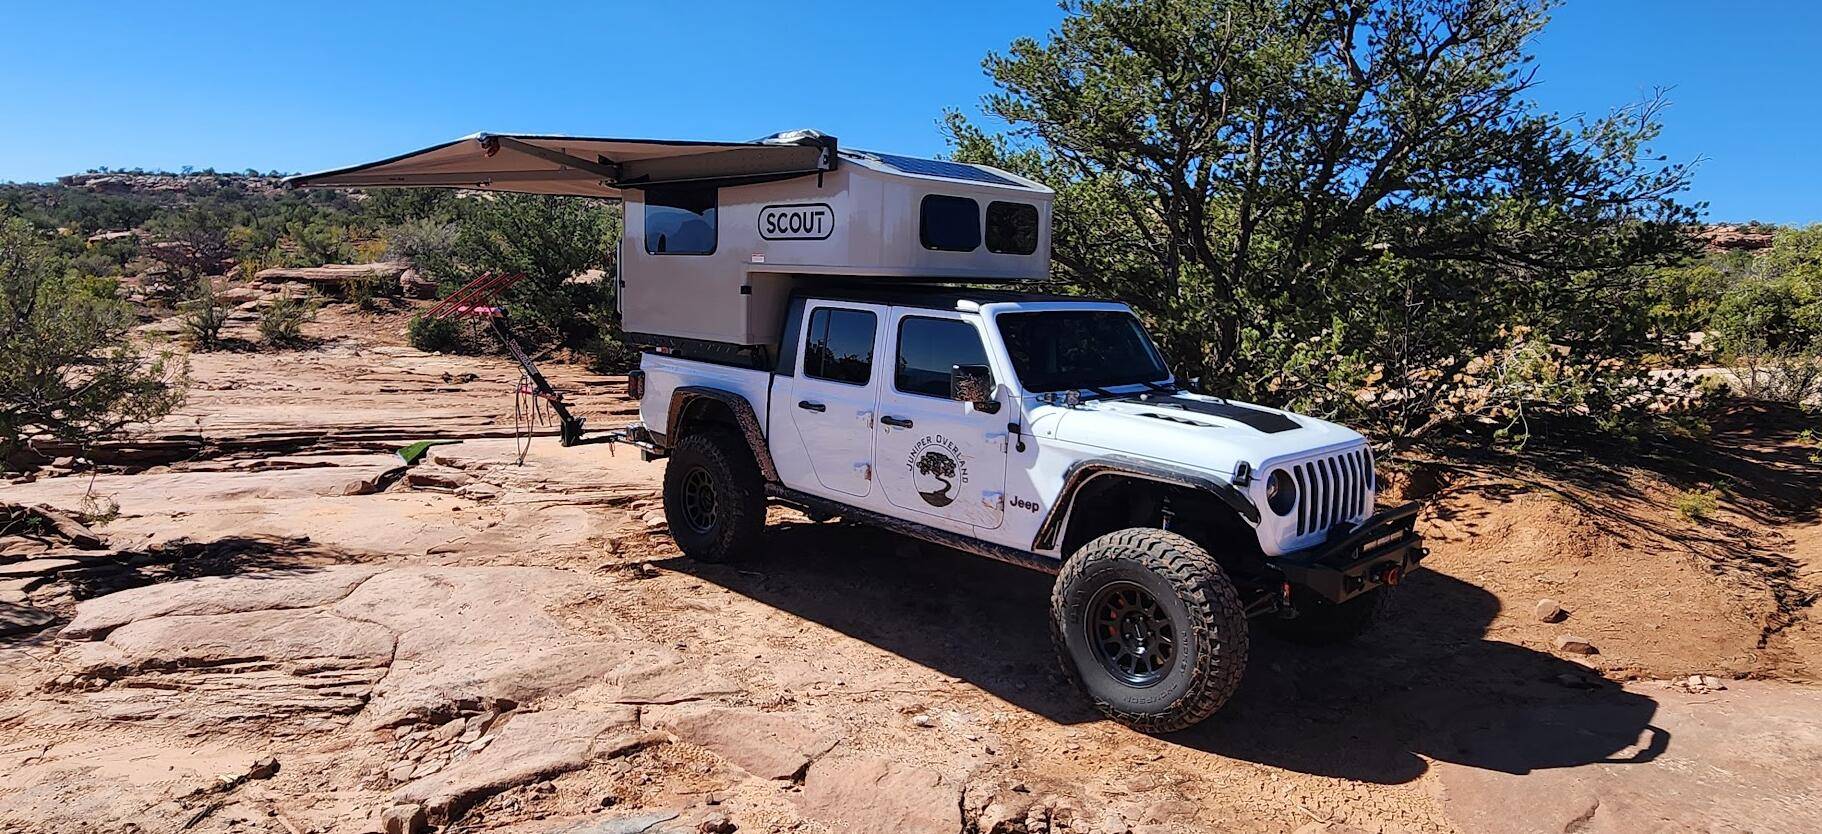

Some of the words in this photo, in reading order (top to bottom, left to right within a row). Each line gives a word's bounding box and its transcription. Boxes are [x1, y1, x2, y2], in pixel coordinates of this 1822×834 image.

[766, 211, 825, 233] SCOUT
[906, 436, 932, 471] JUNIPER
[936, 434, 969, 483] OVERLAND
[1009, 495, 1040, 513] Jeep
